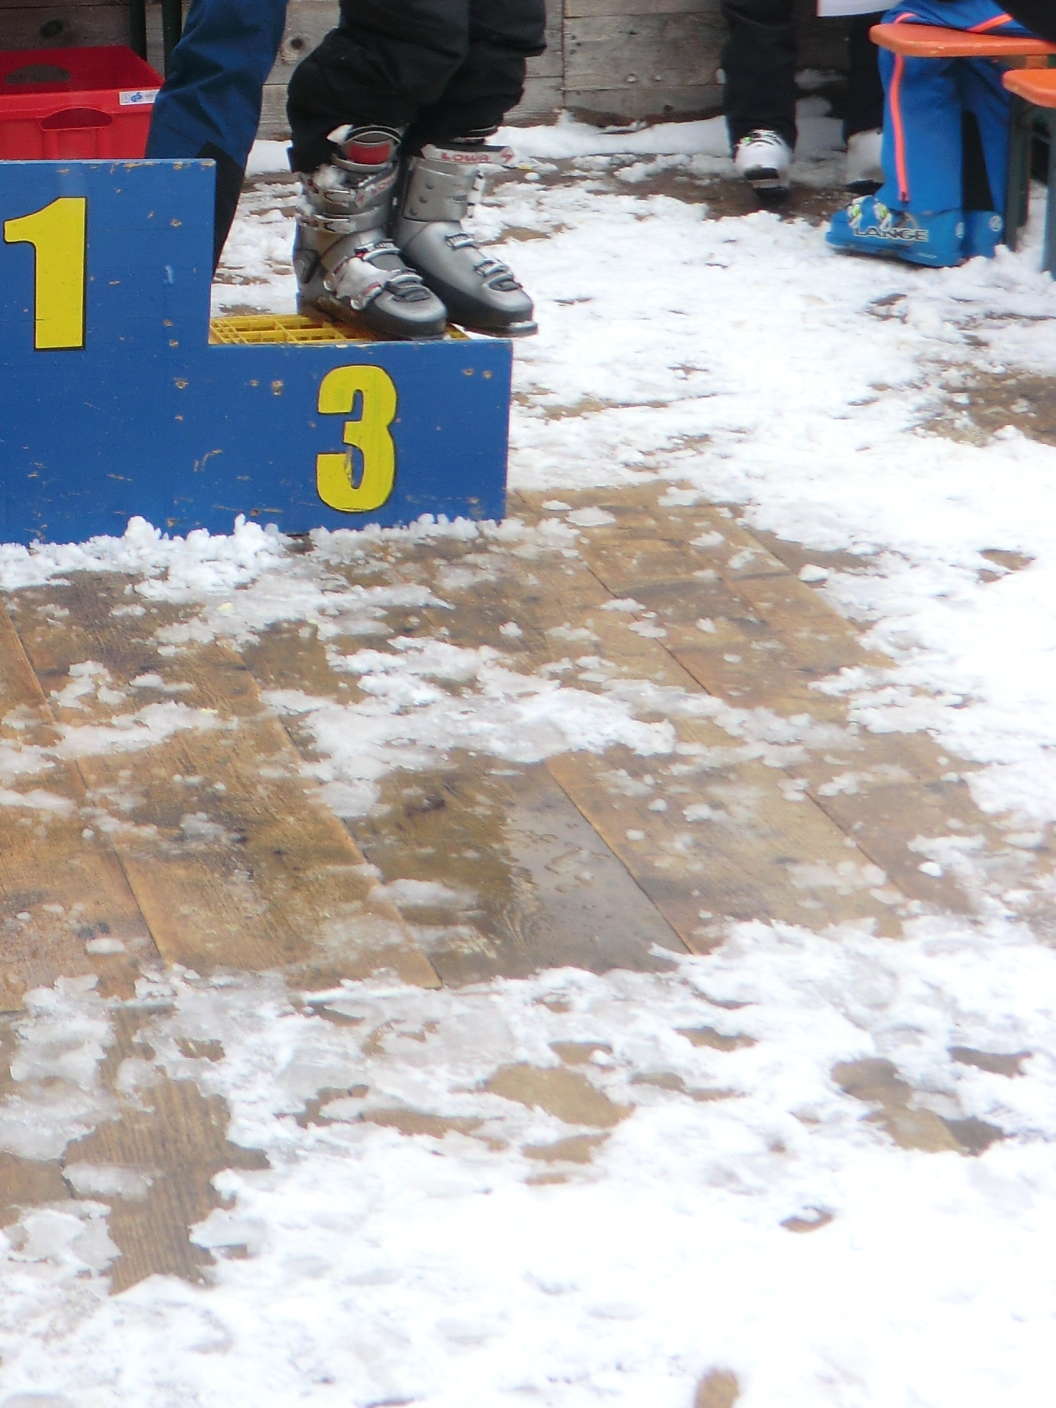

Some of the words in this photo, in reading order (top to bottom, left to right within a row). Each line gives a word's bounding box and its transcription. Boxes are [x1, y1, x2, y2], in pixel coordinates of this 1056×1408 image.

[3, 196, 87, 352] 1
[853, 225, 929, 242] LANGE
[316, 364, 397, 513] 3
